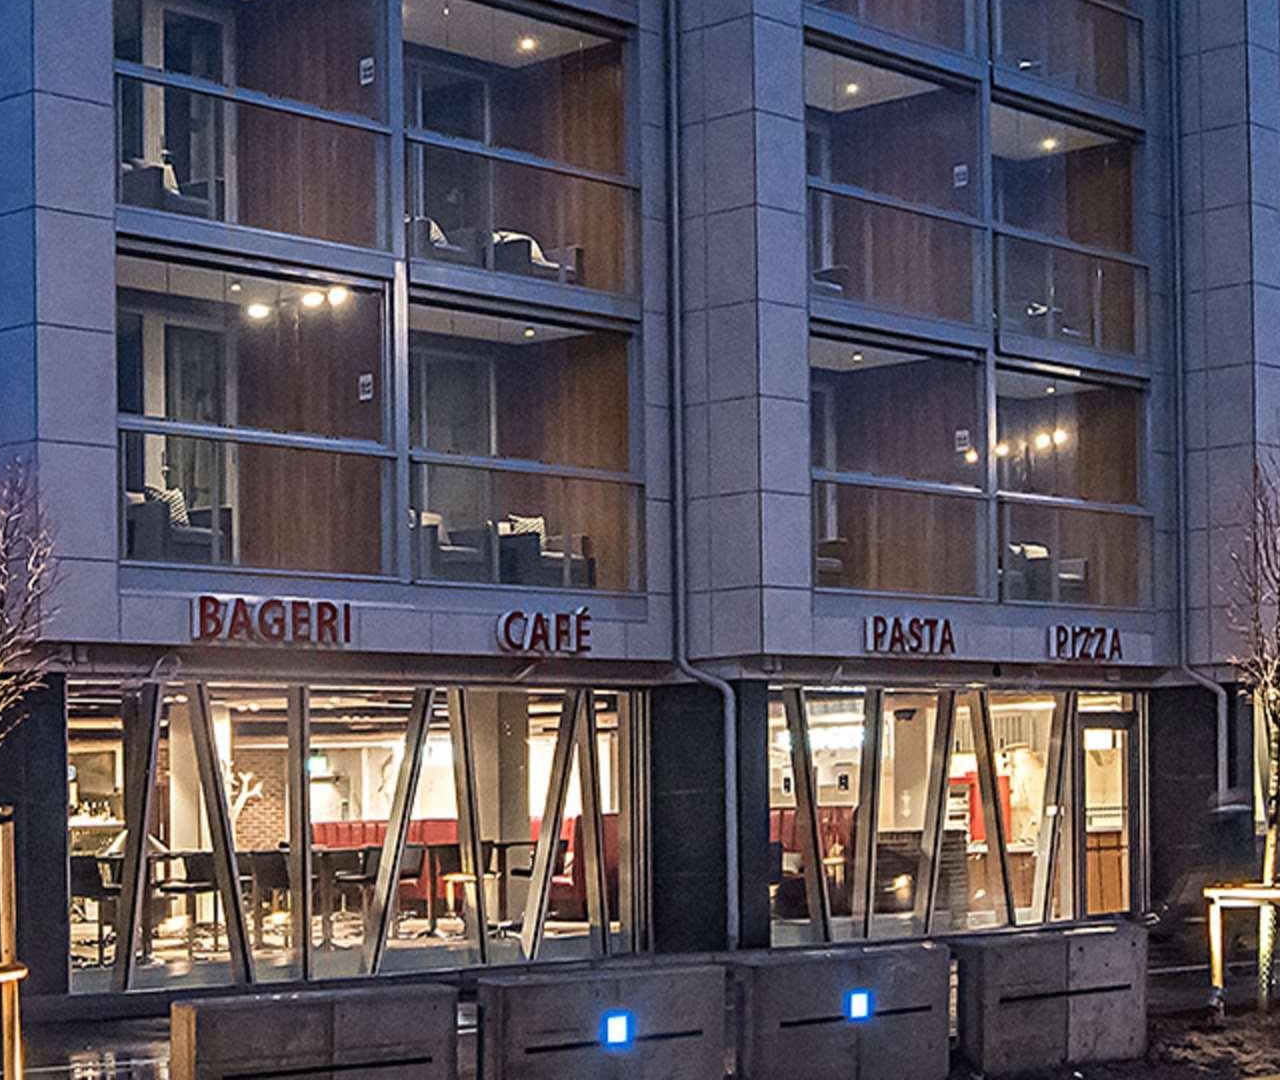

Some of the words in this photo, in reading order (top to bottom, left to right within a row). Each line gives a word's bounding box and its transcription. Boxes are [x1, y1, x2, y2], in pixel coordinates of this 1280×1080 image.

[196, 594, 352, 645] BAGERI
[499, 606, 592, 654] CAFÉ
[870, 615, 957, 655] PASTA
[1055, 624, 1123, 661] PIZZA
